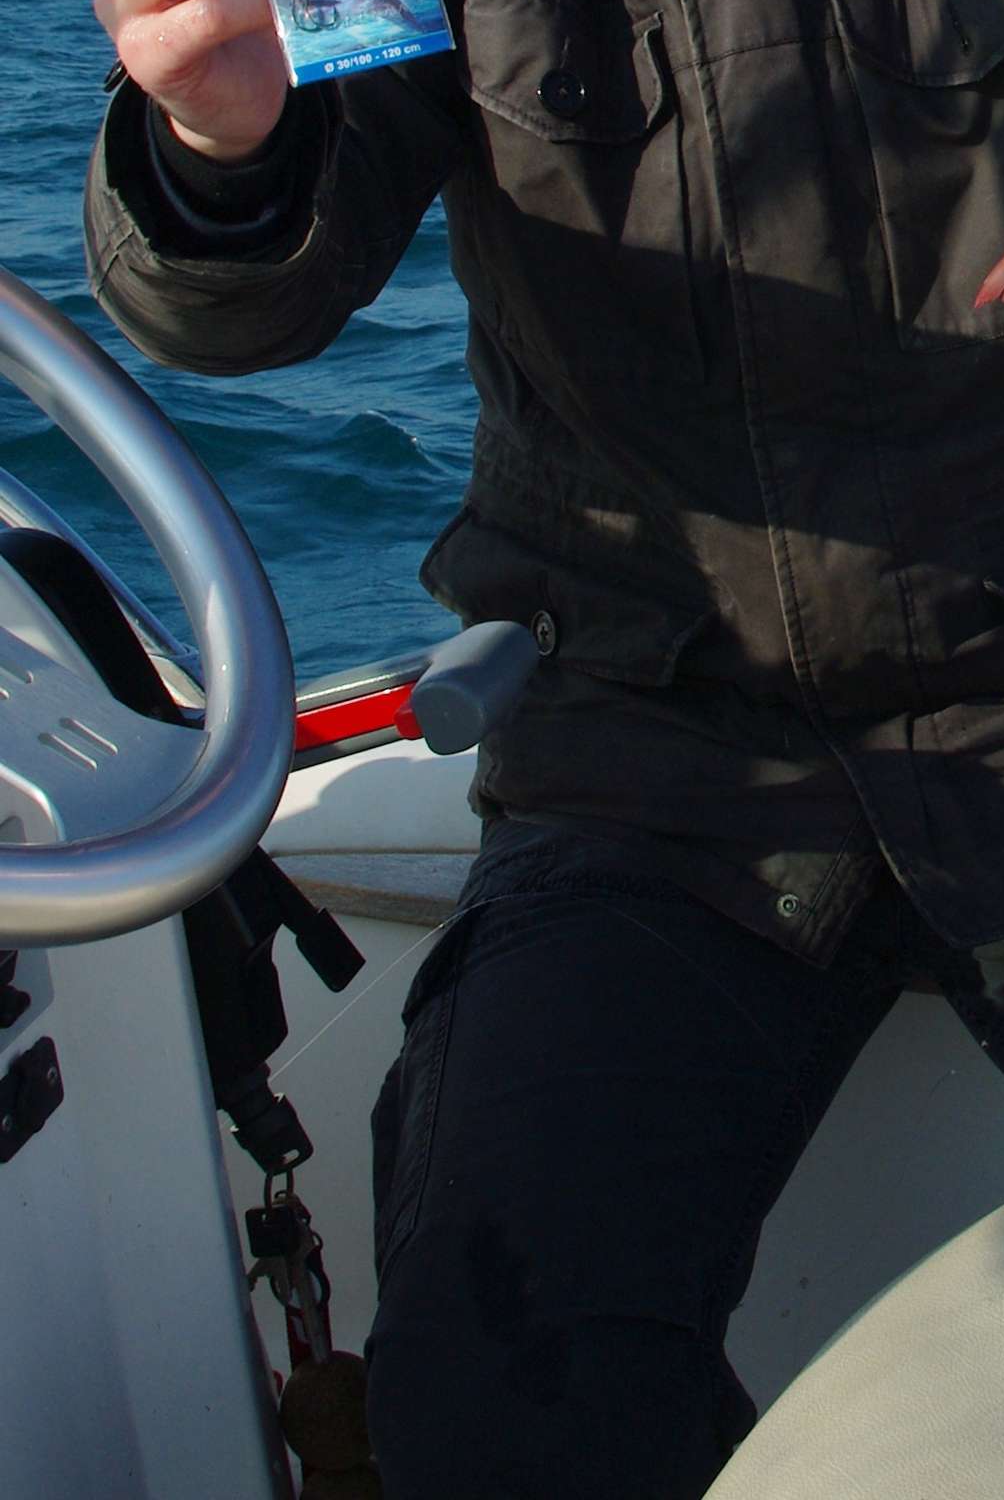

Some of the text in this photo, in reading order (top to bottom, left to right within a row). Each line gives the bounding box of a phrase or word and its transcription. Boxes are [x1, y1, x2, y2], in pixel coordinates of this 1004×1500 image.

[336, 53, 373, 70] 30/100
[382, 46, 402, 59] 120
[403, 43, 421, 54] cm
